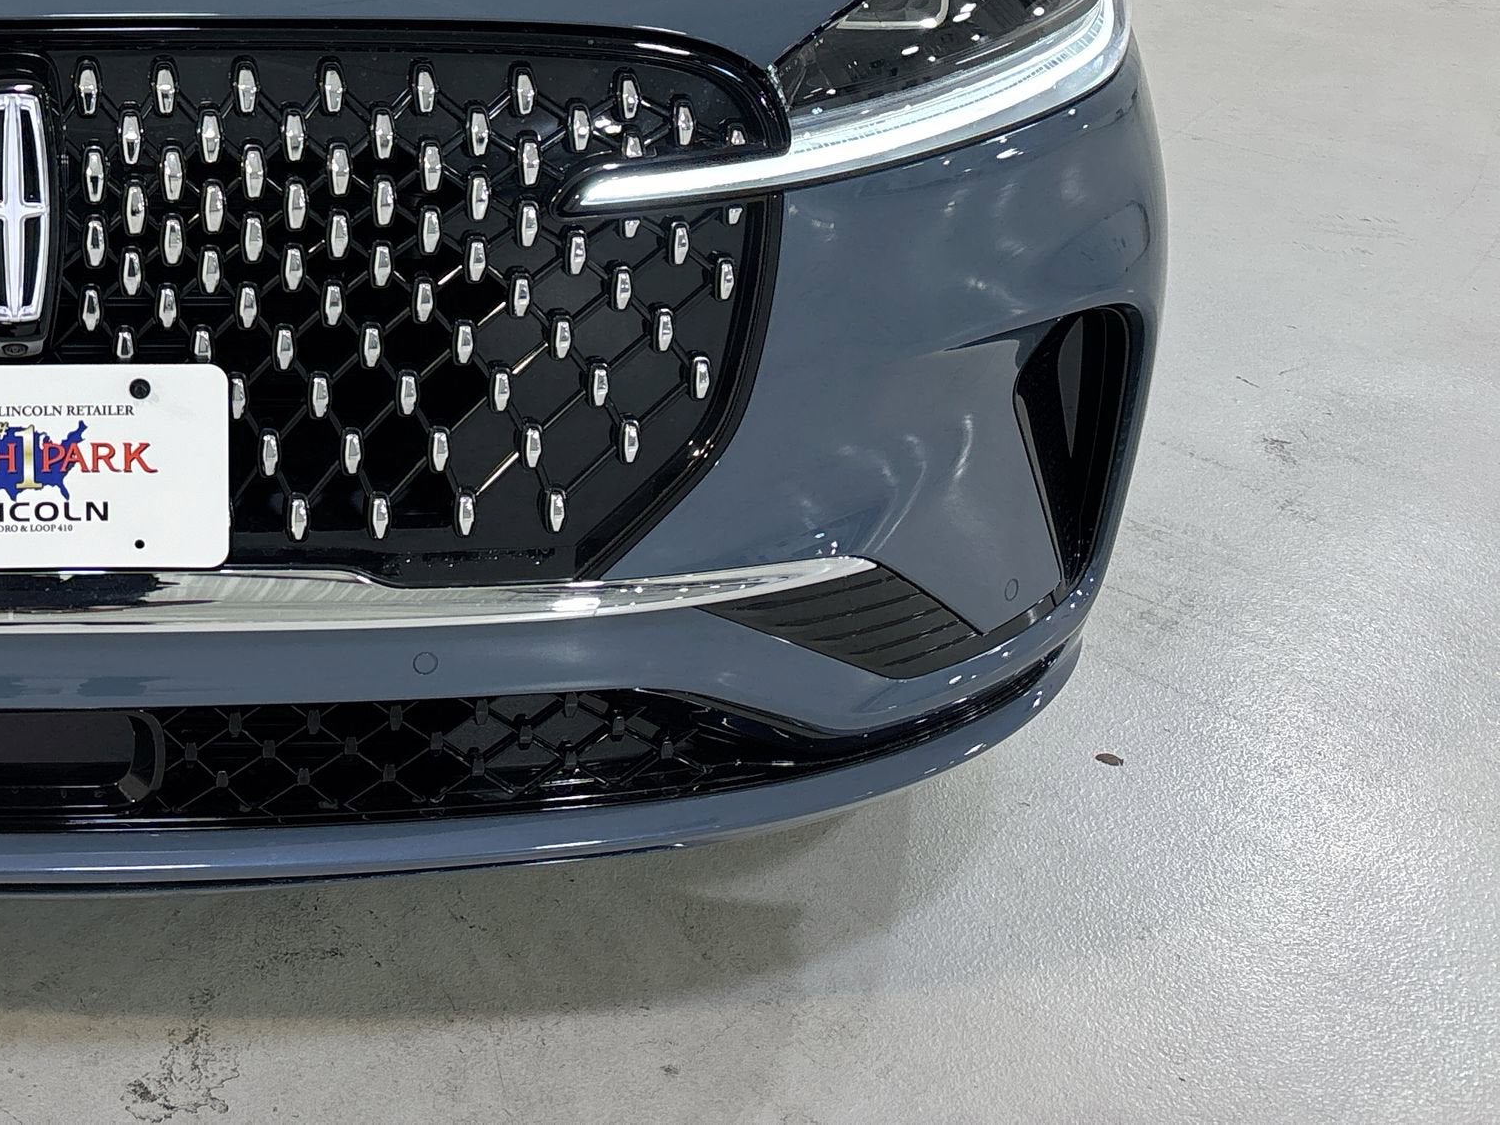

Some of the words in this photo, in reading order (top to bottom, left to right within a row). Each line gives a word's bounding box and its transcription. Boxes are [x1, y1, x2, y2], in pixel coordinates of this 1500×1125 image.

[65, 404, 135, 417] RETAILER
[41, 442, 159, 474] PARK
[20, 524, 28, 533] &
[29, 524, 56, 533] LOOP
[57, 524, 74, 532] 410
